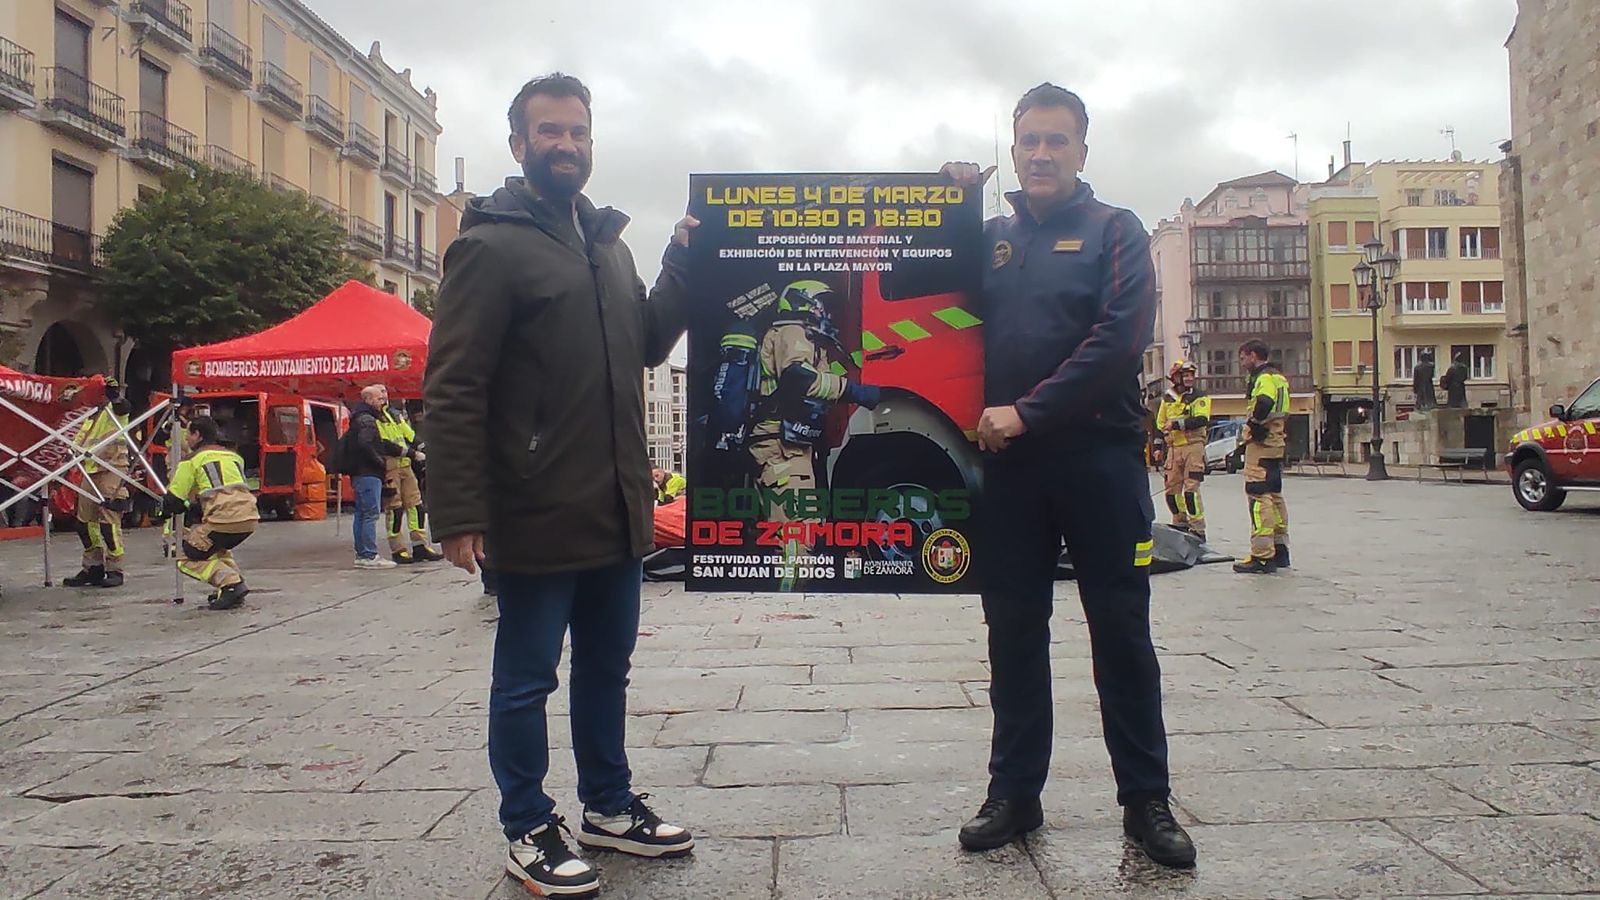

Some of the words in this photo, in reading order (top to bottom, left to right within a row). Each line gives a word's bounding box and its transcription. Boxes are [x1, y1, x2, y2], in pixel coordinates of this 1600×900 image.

[706, 186, 796, 204] LUNES
[800, 186, 821, 204] 4
[829, 186, 868, 204] DE
[873, 186, 964, 204] MARZO
[728, 209, 764, 228] DE
[773, 209, 840, 228] 10:30
[847, 209, 866, 228] A
[874, 209, 942, 228] 18:30
[758, 233, 827, 245] EXPOSICIÓN
[828, 235, 844, 245] DE
[846, 235, 902, 245] MATERIAL
[904, 235, 913, 245] Y
[719, 247, 785, 258] EXHIBICIÓN
[787, 249, 803, 258] DE
[805, 247, 890, 258] INTERVENCIÓN
[892, 249, 900, 258] Y
[902, 249, 953, 258] EQUIPOS
[778, 263, 794, 272] EN
[796, 263, 811, 272] LA
[813, 263, 850, 272] PLAZA
[852, 263, 893, 272] MAYOR
[204, 360, 258, 377] BOMBEROS
[259, 357, 330, 377] AYUNTAMIENTO
[332, 356, 346, 374] DE
[692, 487, 971, 519] BOMBEROS
[691, 520, 744, 546] DE
[756, 520, 913, 547] ZAMORA
[693, 555, 765, 565] FESTIVIDAD
[766, 555, 786, 565] DEL
[788, 553, 834, 565] PATRÓN
[693, 567, 724, 578] SAN
[728, 567, 772, 578] JUAN
[774, 567, 794, 579] DE
[798, 567, 836, 579] DIOS
[864, 566, 875, 575] DE
[876, 566, 914, 575] ZAMORA
